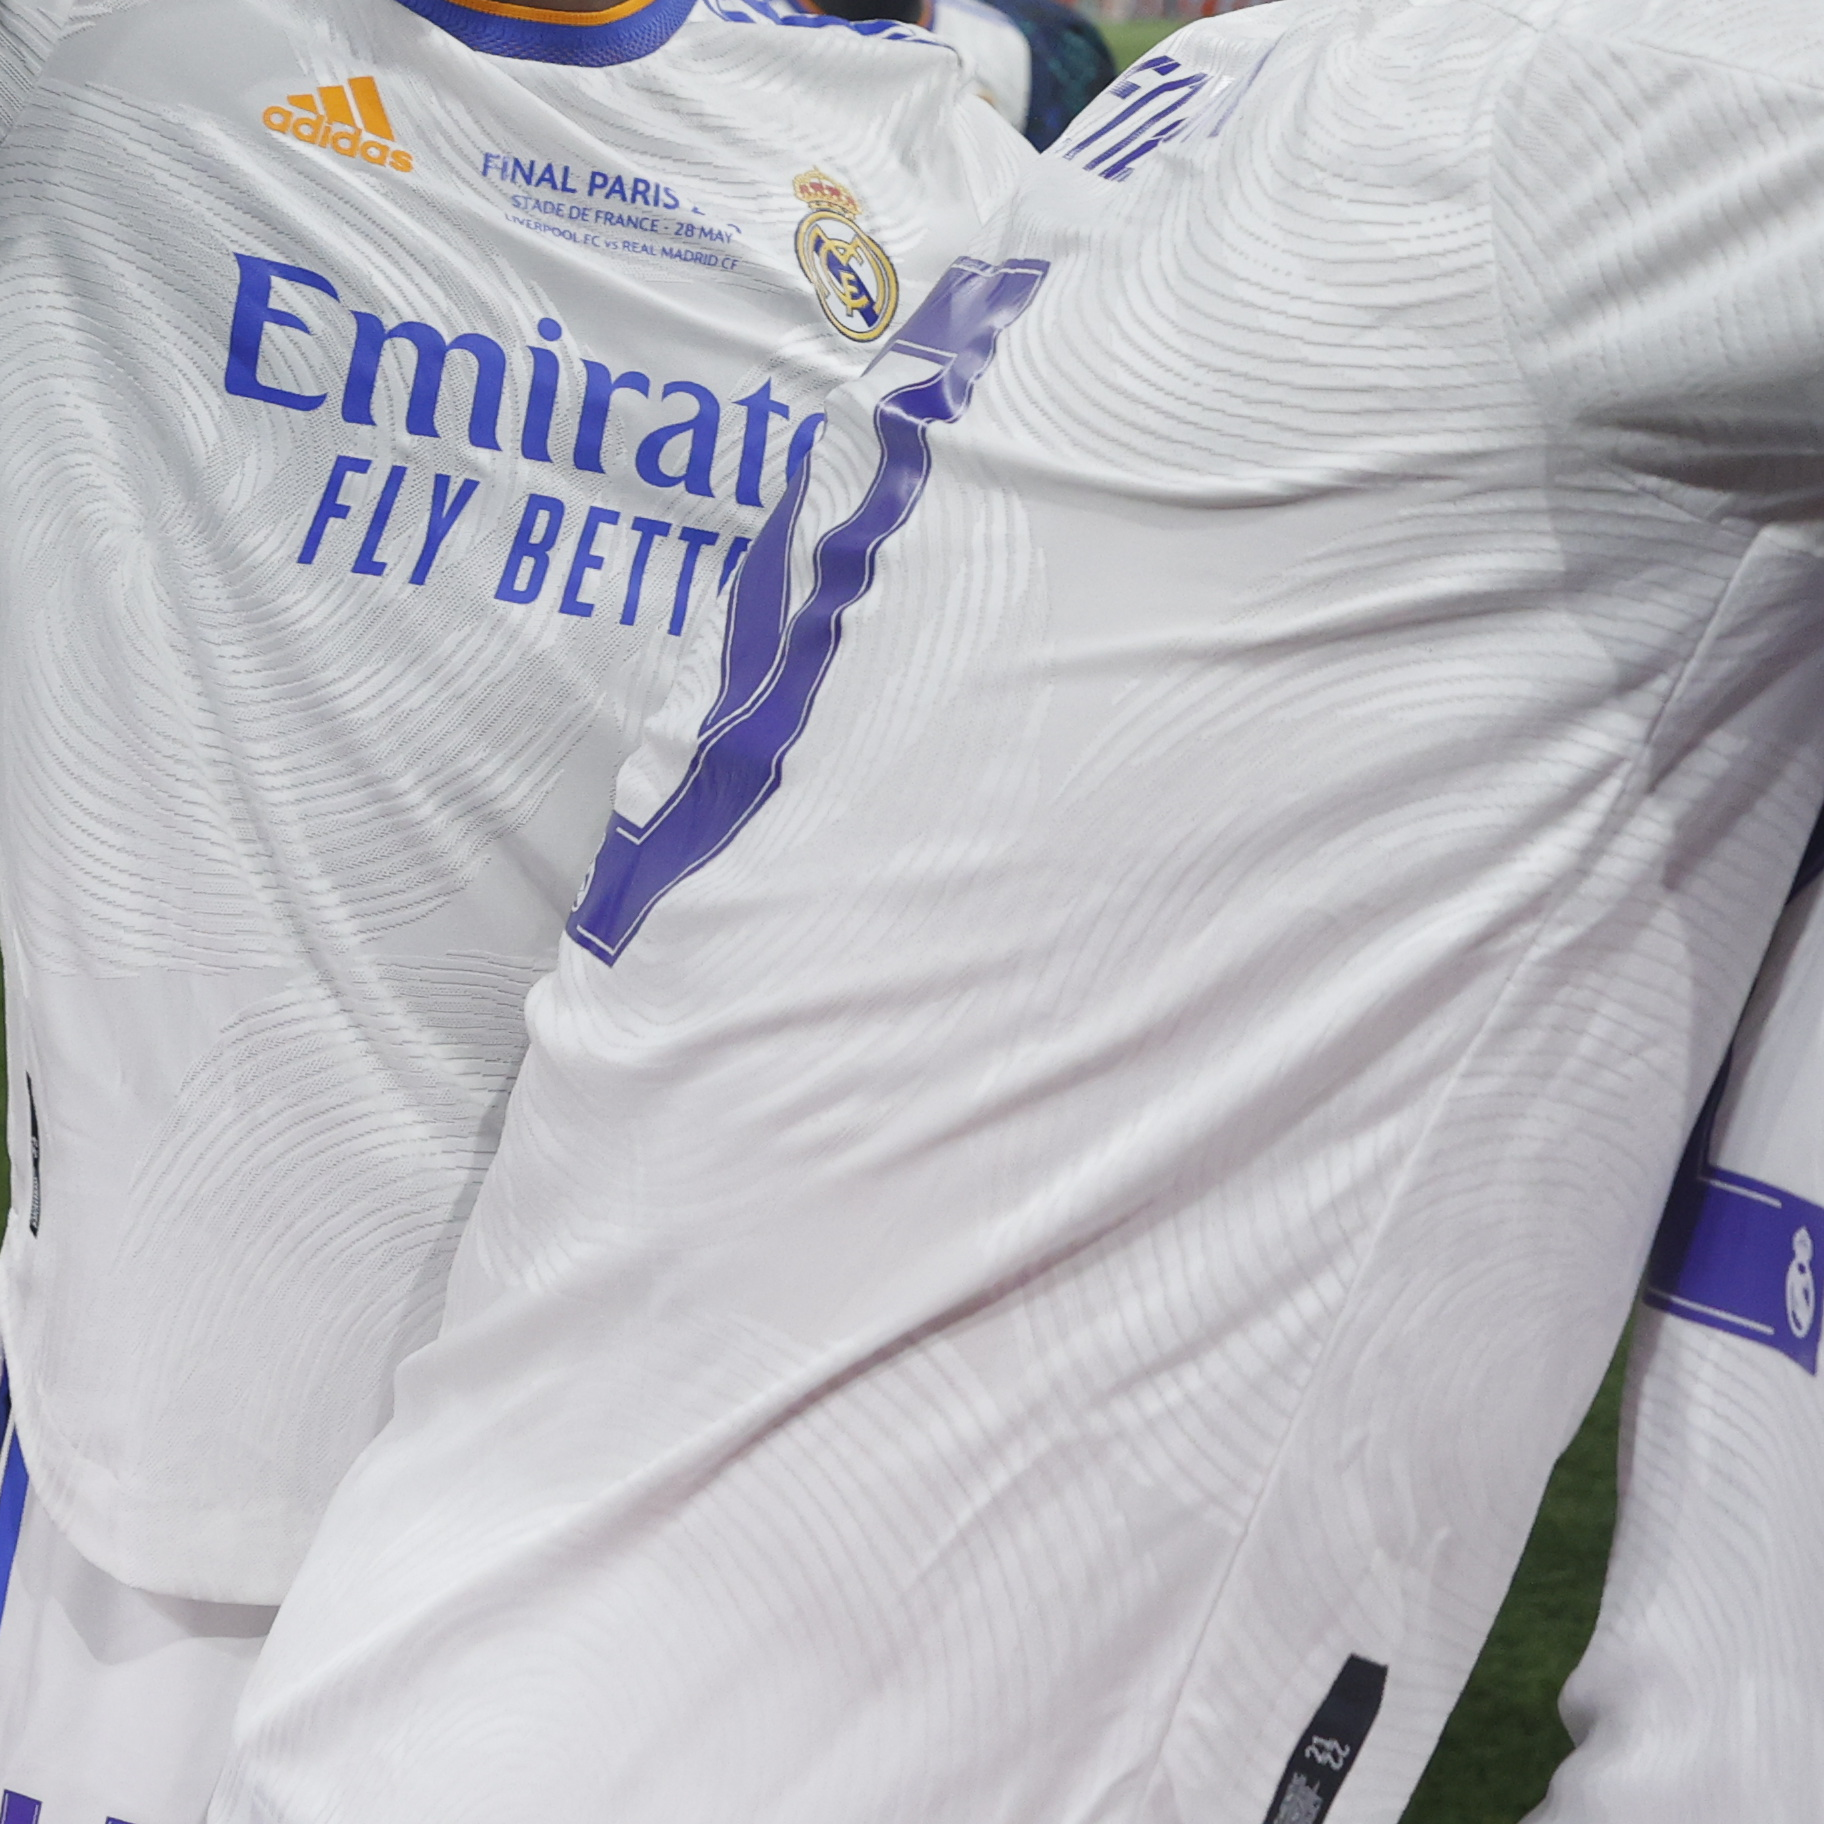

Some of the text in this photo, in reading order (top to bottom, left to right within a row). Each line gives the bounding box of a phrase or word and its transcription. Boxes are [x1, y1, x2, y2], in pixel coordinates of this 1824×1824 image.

[262, 105, 414, 173] adidas
[481, 152, 681, 210] FINAL PARIS
[504, 213, 584, 245] LIVERPOOL
[583, 233, 601, 248] FC
[621, 239, 657, 257] REAL
[660, 246, 719, 268] MADRID
[720, 256, 740, 271] CF
[510, 194, 565, 217] STADE
[569, 206, 590, 223] DE
[594, 208, 661, 233] FRANCE
[673, 221, 695, 239] 28
[698, 226, 734, 245] MAY
[297, 455, 480, 586] FLY
